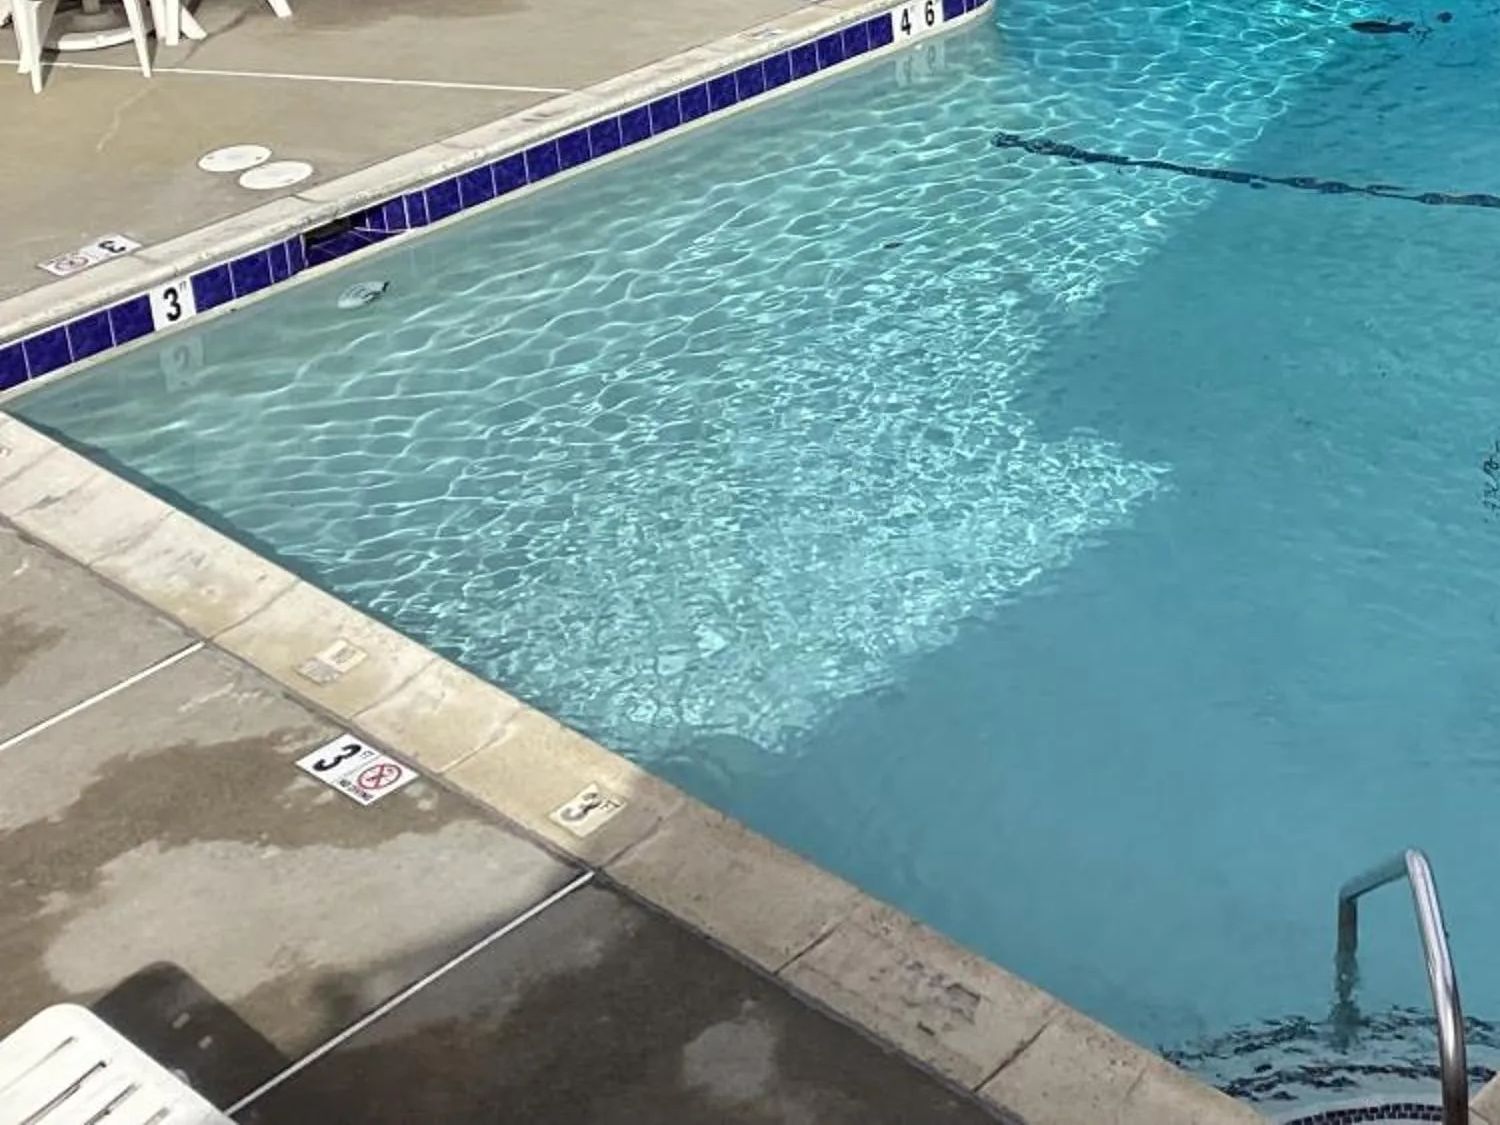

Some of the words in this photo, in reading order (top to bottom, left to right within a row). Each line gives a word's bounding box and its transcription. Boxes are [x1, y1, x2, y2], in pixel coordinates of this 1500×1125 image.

[900, 8, 912, 36] 4
[924, 0, 936, 27] 6
[163, 286, 183, 322] 3
[313, 743, 362, 772] 3
[559, 792, 603, 822] 3
